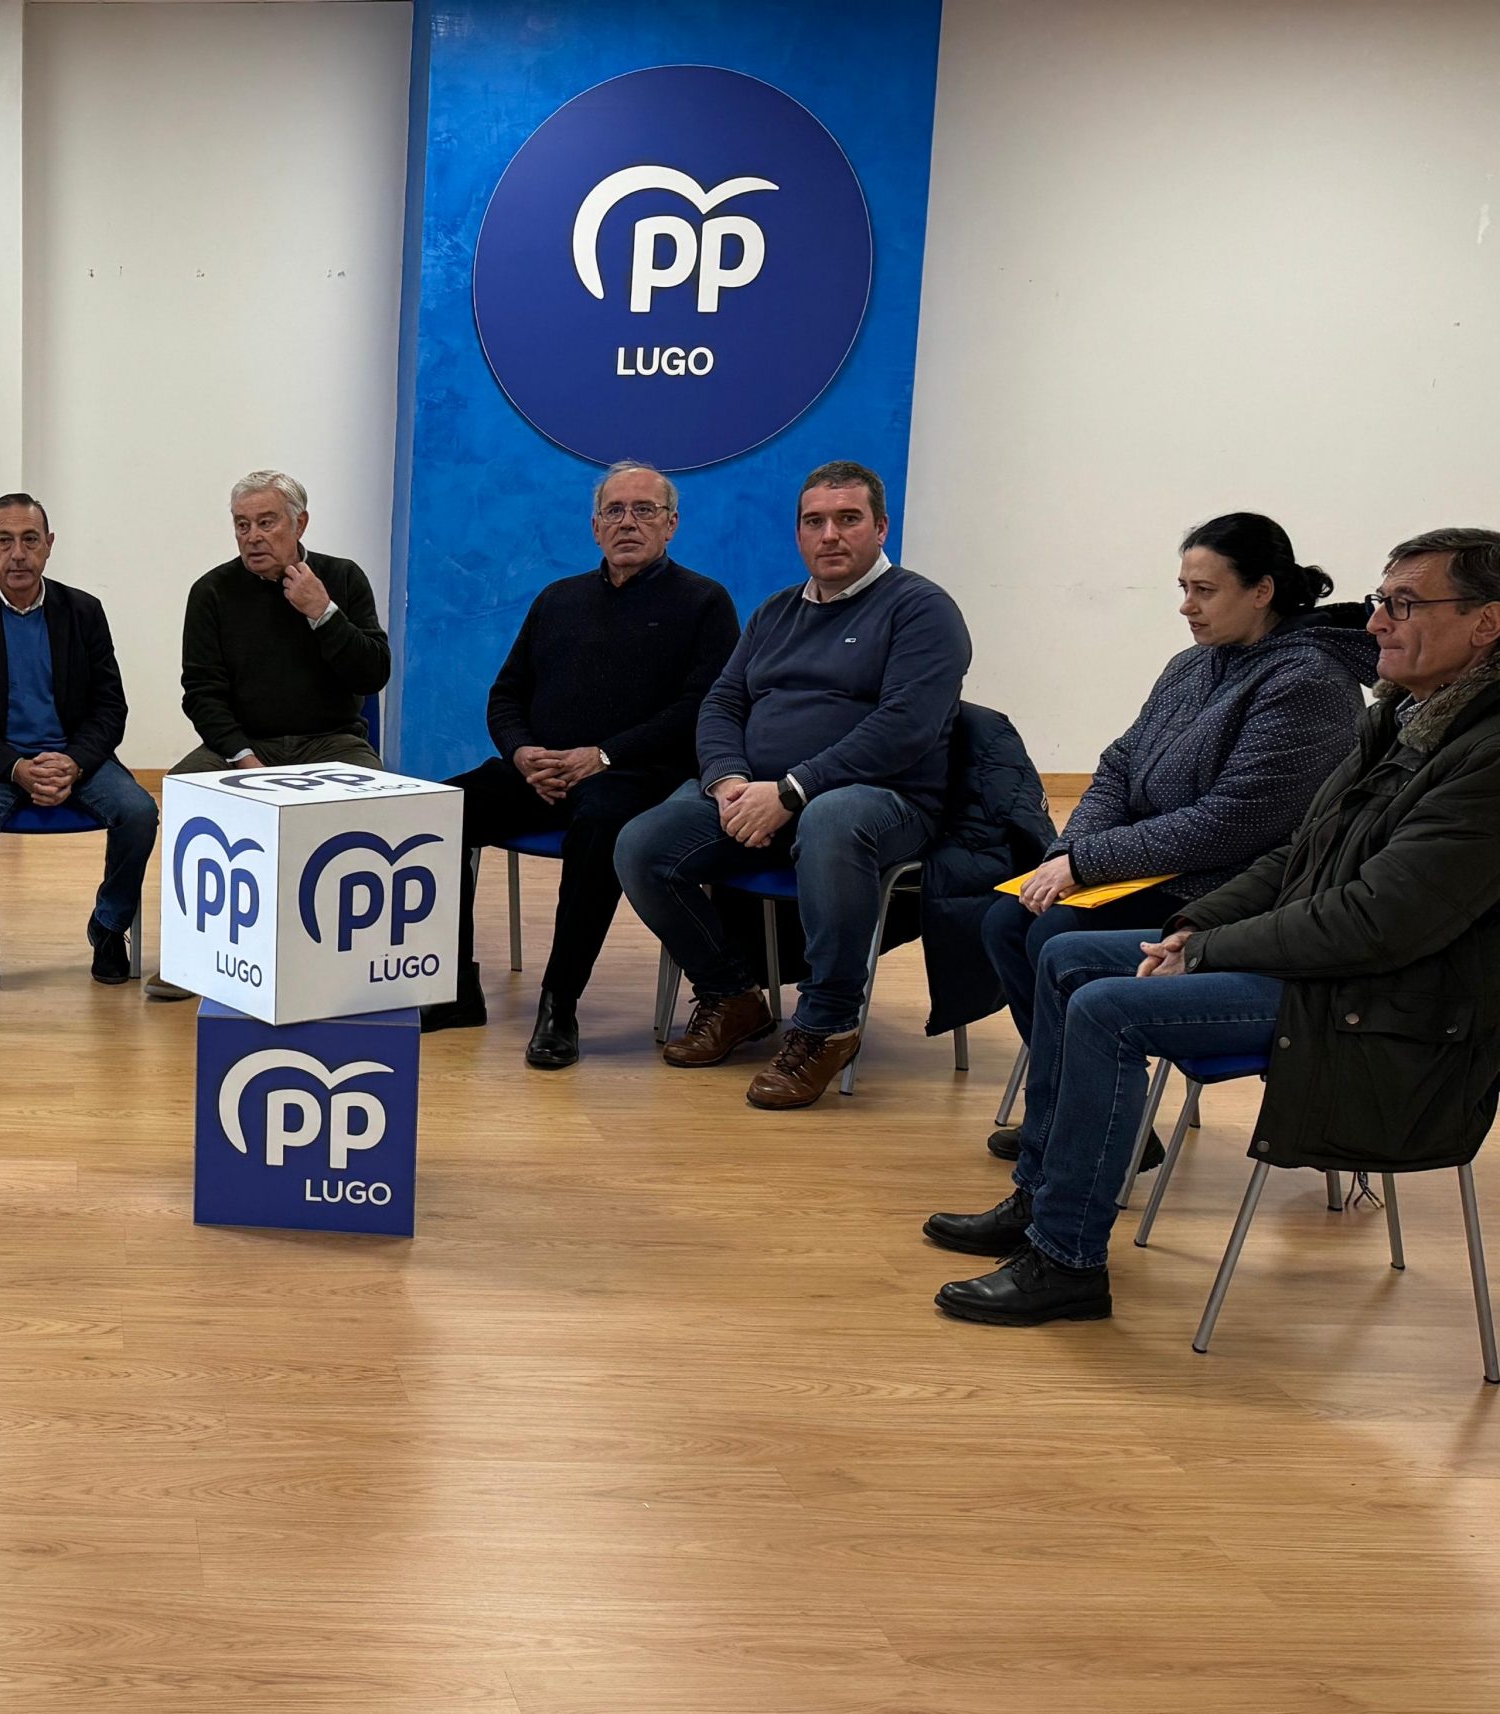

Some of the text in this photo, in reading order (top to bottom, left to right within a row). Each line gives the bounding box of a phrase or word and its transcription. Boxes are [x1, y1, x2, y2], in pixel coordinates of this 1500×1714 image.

[616, 347, 714, 376] LUGO
[216, 950, 263, 988] LUGO
[369, 953, 440, 984] LUGO
[305, 1179, 392, 1206] LUGO
